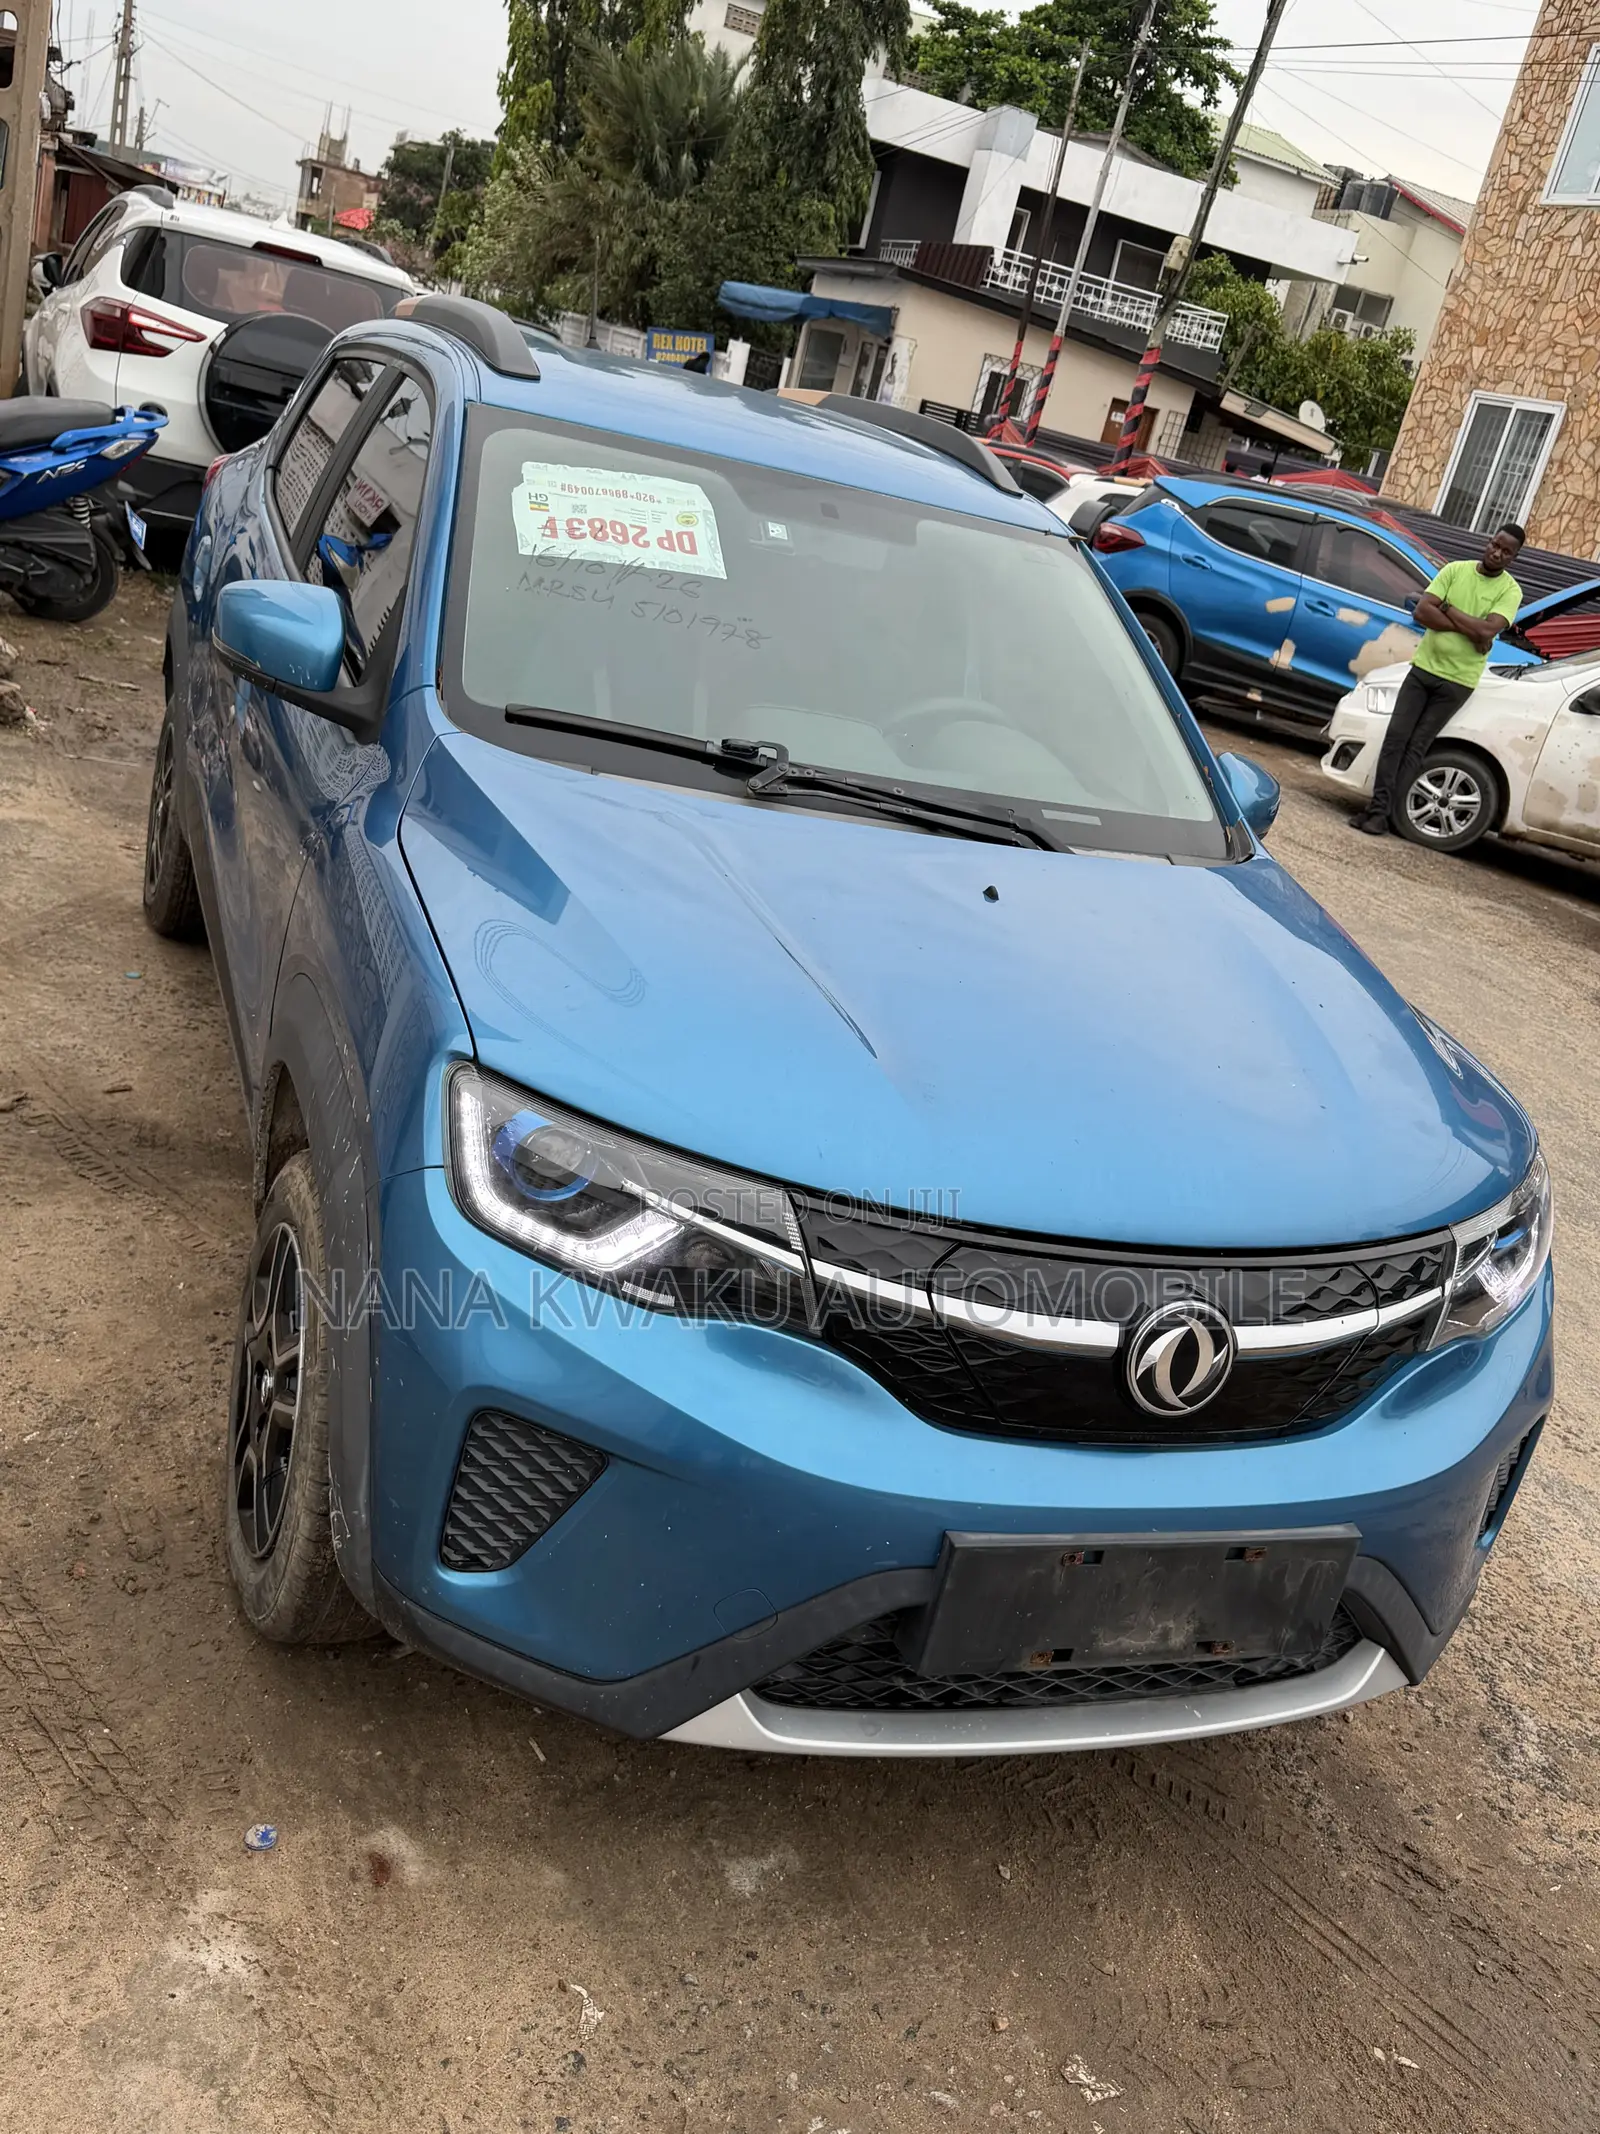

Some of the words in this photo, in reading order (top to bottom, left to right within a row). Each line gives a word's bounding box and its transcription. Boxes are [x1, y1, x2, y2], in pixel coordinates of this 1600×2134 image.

[675, 335, 706, 352] HOTEL
[528, 491, 549, 502] GH
[565, 517, 651, 548] 2683
[656, 529, 698, 555] DP
